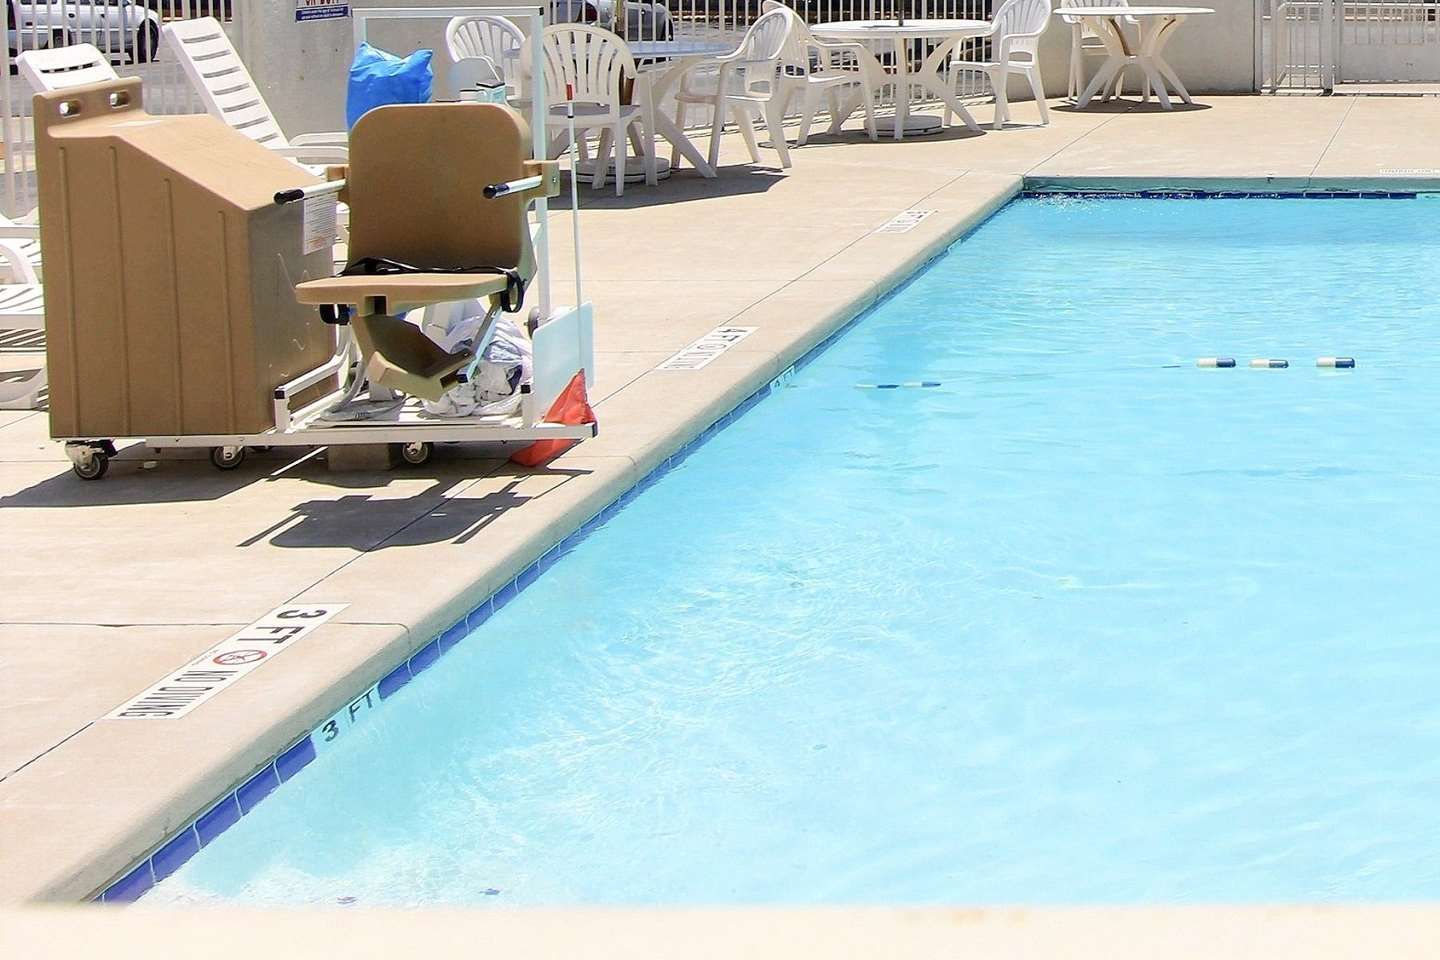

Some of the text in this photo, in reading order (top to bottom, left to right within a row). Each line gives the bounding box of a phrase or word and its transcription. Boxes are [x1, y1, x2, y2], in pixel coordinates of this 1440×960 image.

[118, 609, 327, 718] 3 FT NO DIVING
[321, 690, 375, 742] 3 FT
